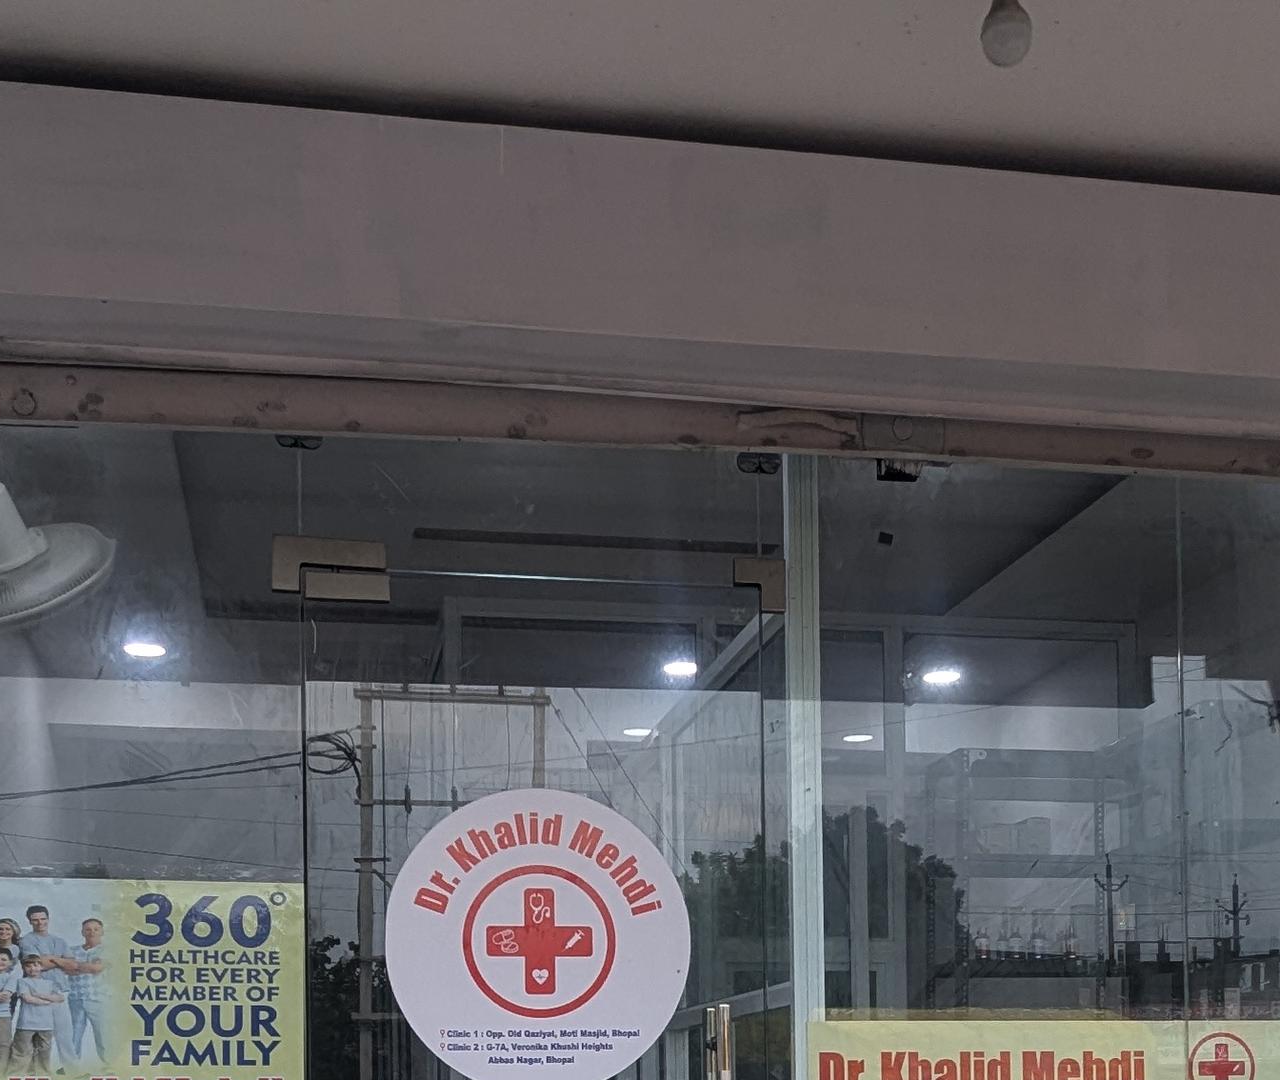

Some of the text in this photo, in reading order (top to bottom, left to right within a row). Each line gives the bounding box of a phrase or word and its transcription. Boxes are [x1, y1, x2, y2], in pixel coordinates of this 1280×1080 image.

[413, 812, 663, 917] Dr. Khalid Mehdi
[129, 949, 280, 965] HEALTHCARE
[131, 966, 281, 984] FOR EVERY
[130, 985, 280, 1002] MEMBER OF
[130, 1003, 281, 1038] YOUR
[447, 1030, 471, 1038] Clinic
[486, 1030, 506, 1039] Opp.
[612, 1029, 640, 1039] Bhopal
[132, 1039, 281, 1067] FAMILY
[447, 1043, 471, 1051] Clinic
[473, 1043, 479, 1051] 2
[511, 1043, 549, 1051] Veronika
[550, 1042, 579, 1051] Khushi
[581, 1042, 613, 1052] Heights
[488, 1056, 575, 1065] Abbas Nagar, Bhopal
